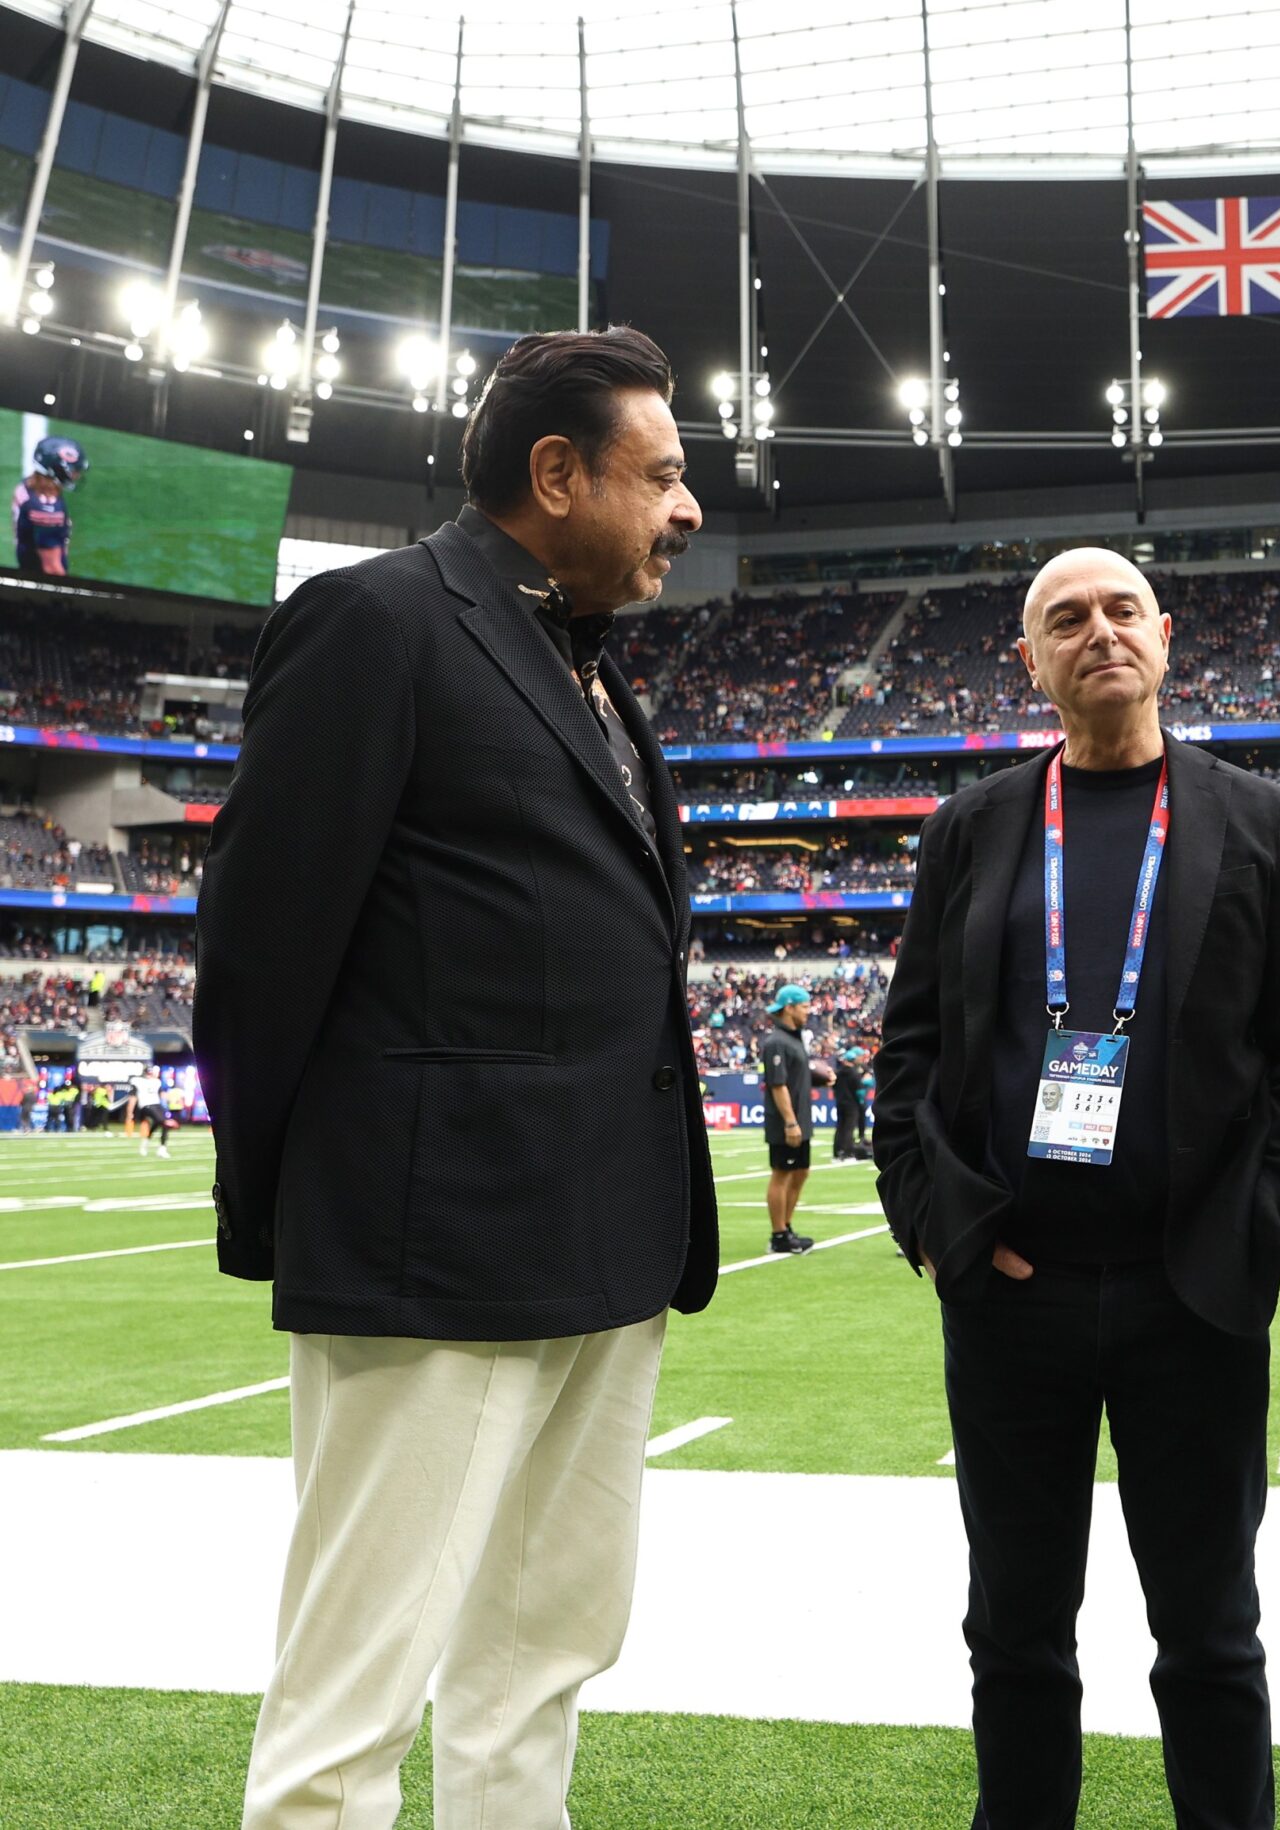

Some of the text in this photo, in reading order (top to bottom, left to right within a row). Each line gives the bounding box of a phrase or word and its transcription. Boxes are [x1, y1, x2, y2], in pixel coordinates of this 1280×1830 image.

[1165, 726, 1213, 742] AMES
[1132, 855, 1156, 947] 2024 NFL LONDON GAMES
[1051, 912, 1059, 926] NFL
[1051, 927, 1059, 946] 2024
[1048, 1060, 1119, 1078] GAMEDAY
[703, 1103, 737, 1124] NFL
